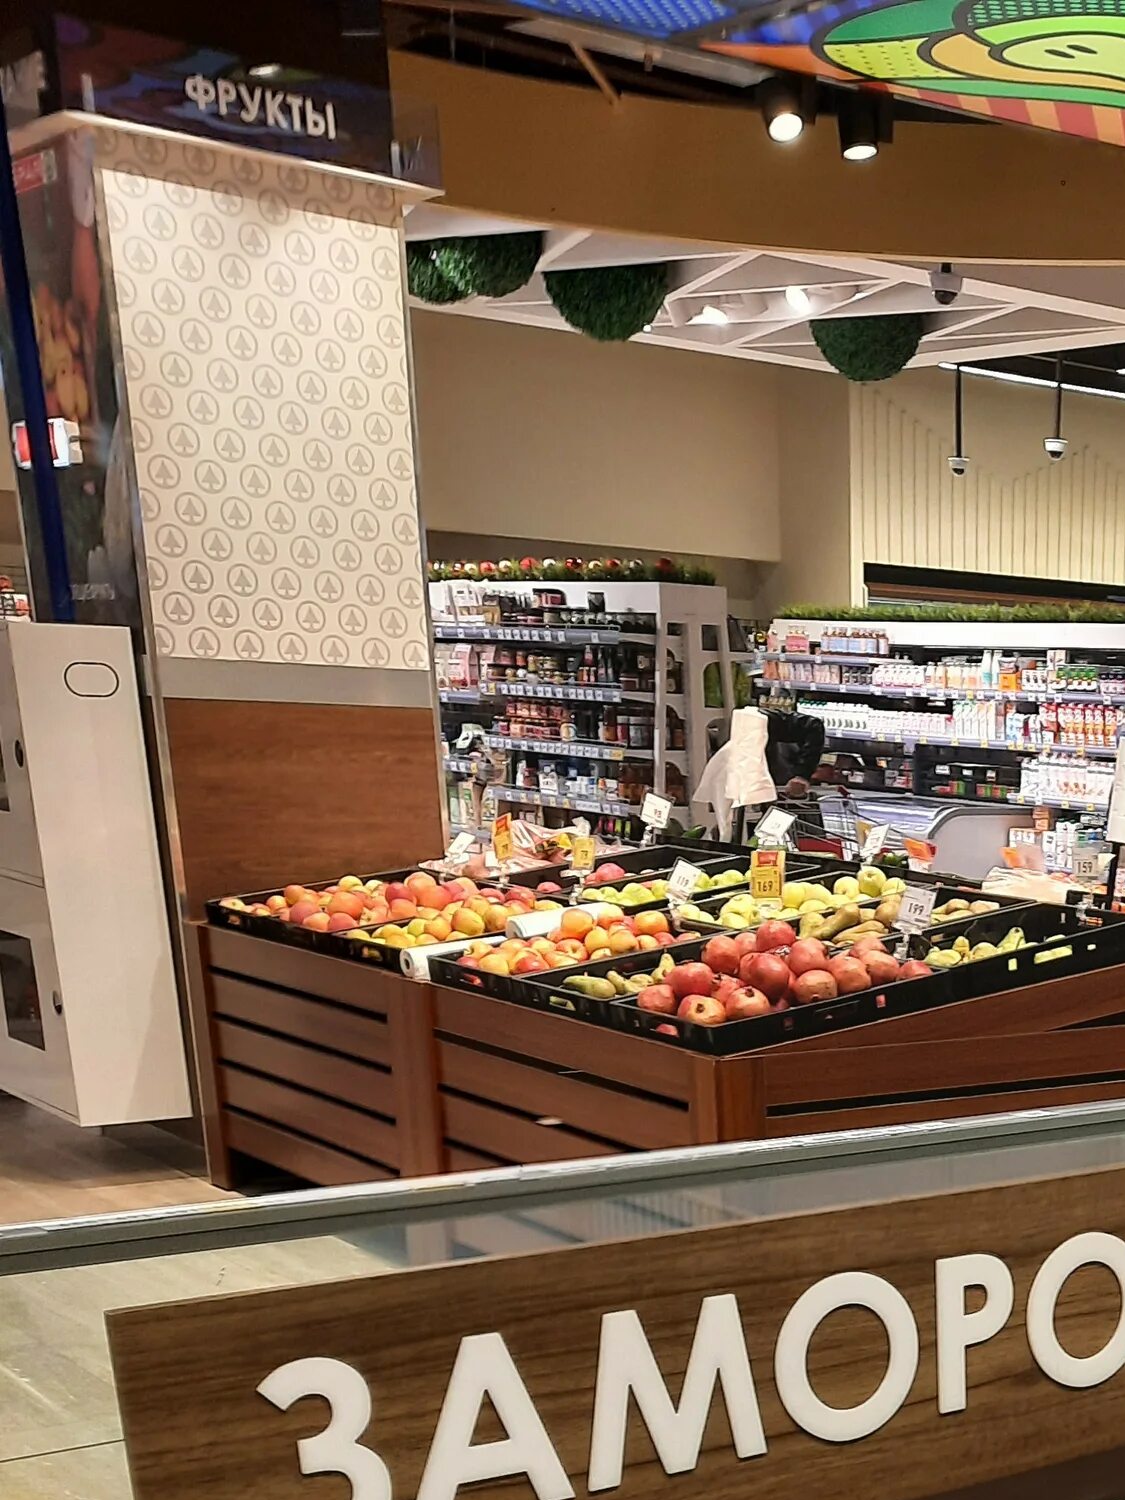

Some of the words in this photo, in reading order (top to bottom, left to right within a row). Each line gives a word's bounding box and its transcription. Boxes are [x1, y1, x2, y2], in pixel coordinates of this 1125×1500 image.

[184, 73, 337, 141] ФРУКТЫ
[757, 880, 773, 892] 169
[907, 902, 925, 916] 199
